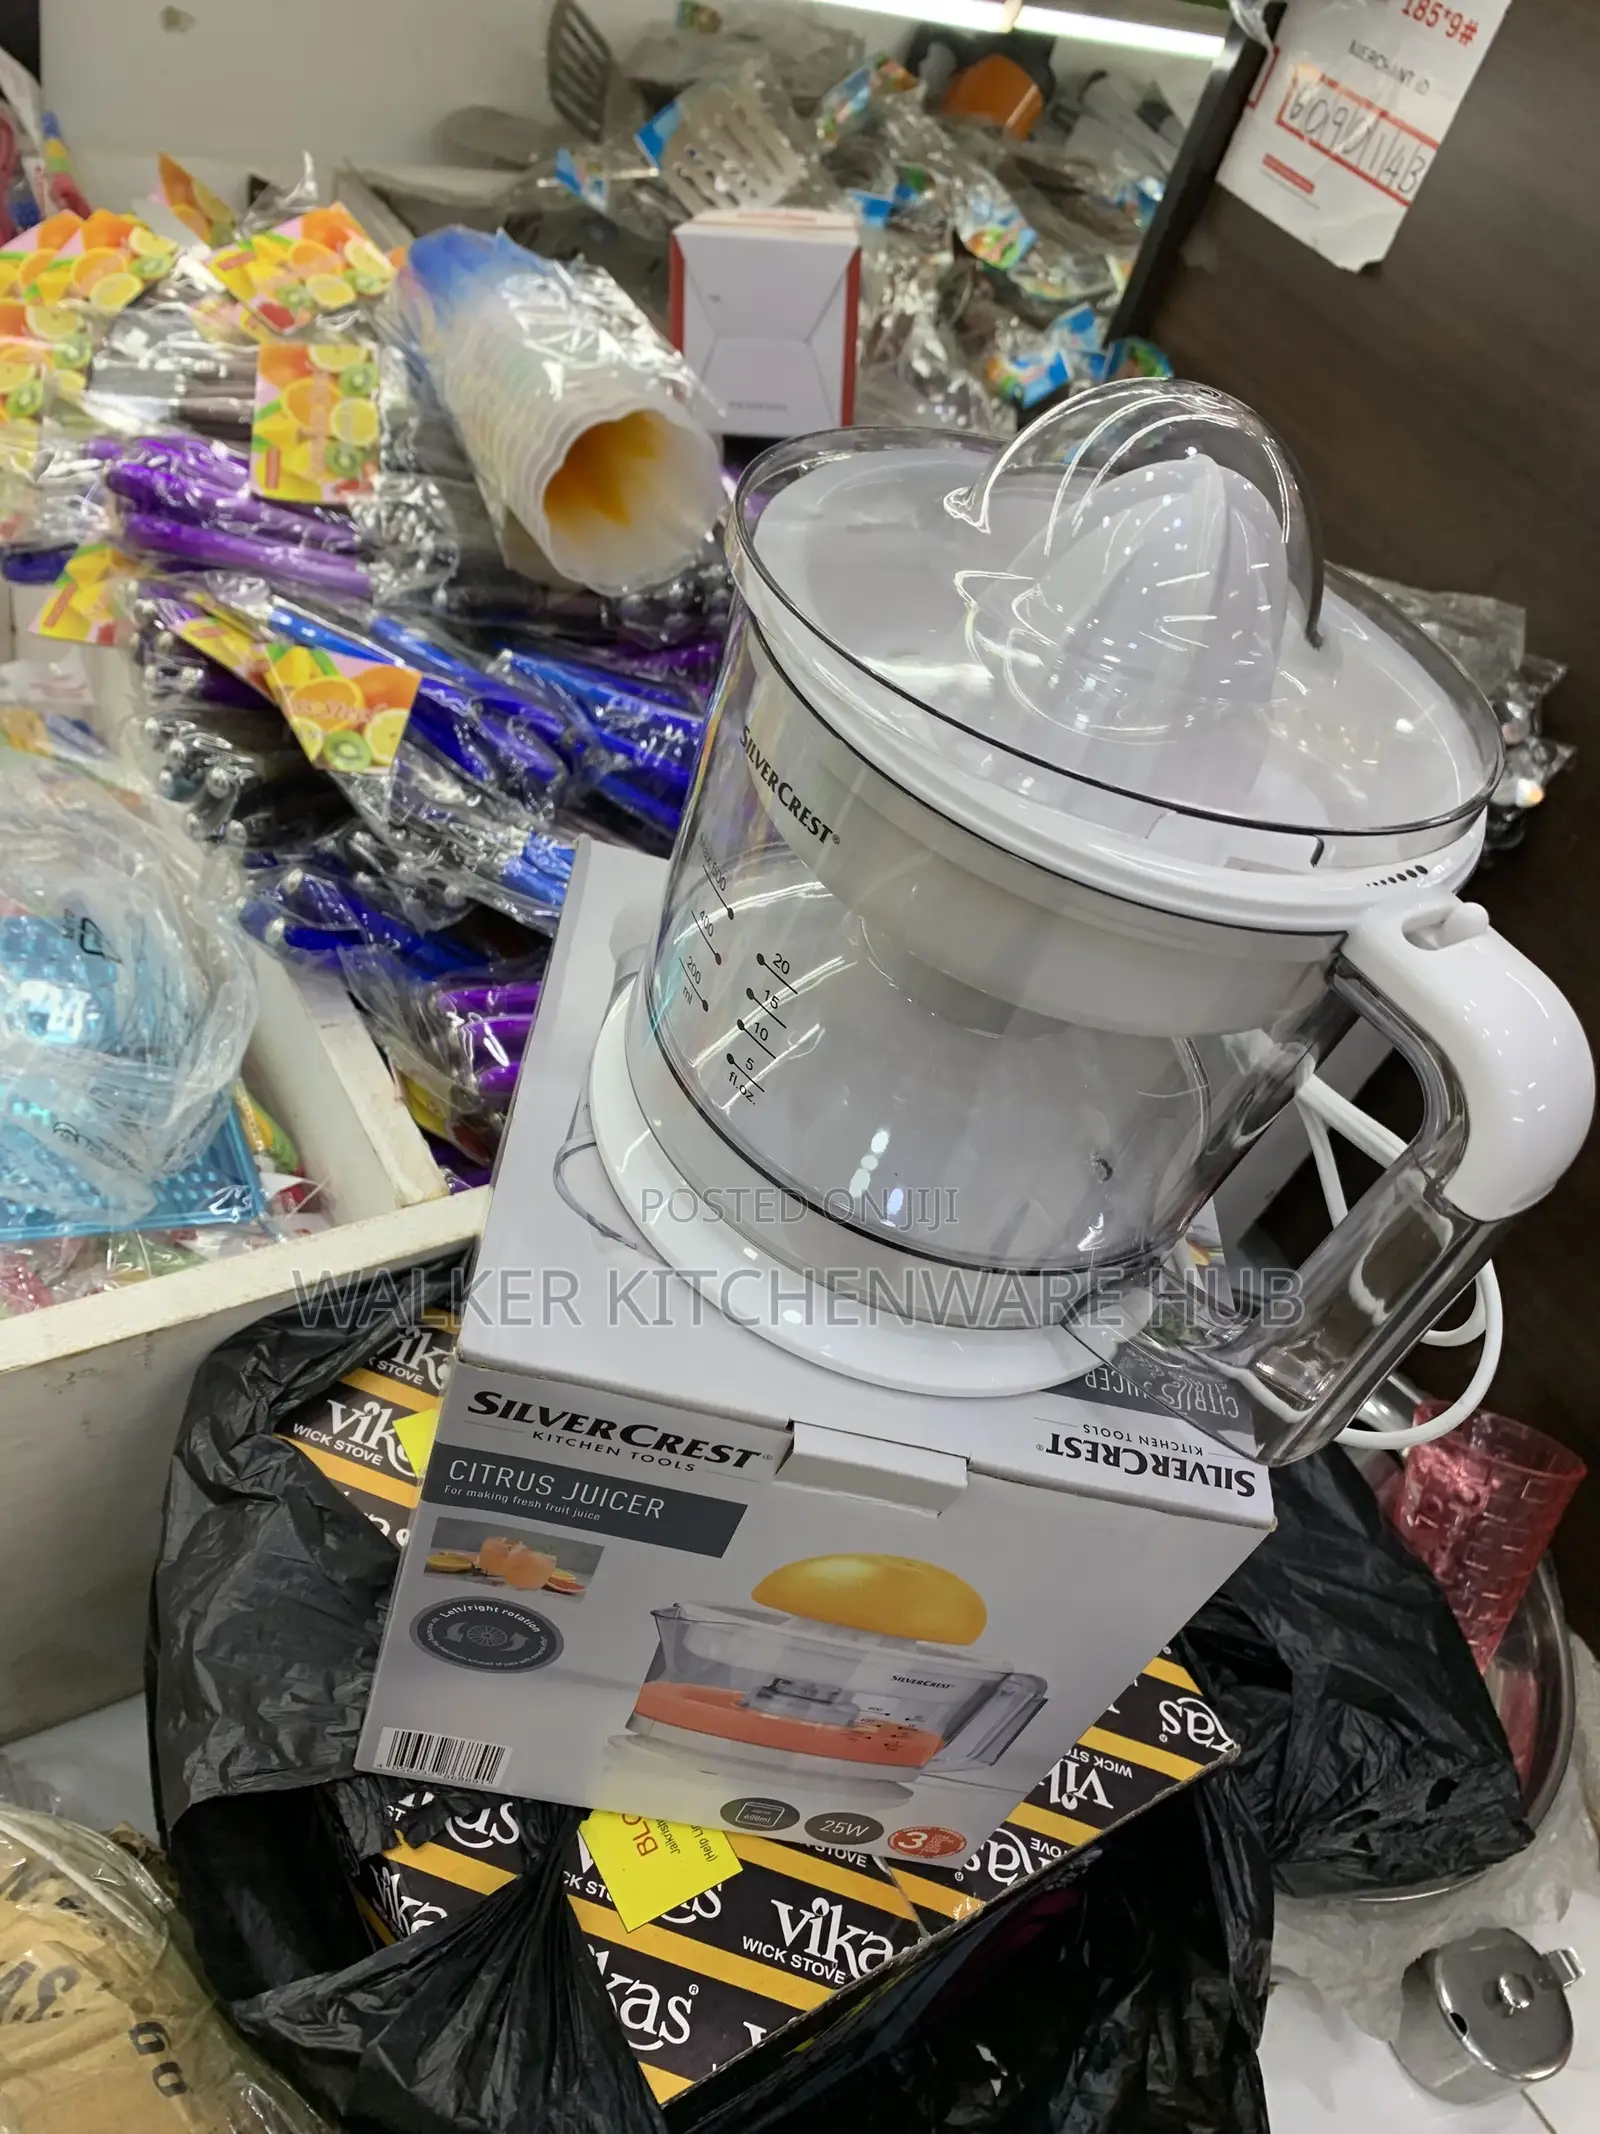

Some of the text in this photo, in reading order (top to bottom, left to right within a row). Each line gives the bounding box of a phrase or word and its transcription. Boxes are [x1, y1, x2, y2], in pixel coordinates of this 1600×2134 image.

[686, 955, 702, 985] 200
[772, 952, 791, 976] 20
[763, 989, 780, 1010] 15
[753, 1021, 770, 1042] 10
[745, 1057, 756, 1072] 5
[376, 1360, 425, 1386] STOVE
[293, 1422, 384, 1467] WICK STOVE
[532, 1430, 697, 1473] KITCHEN TOOLS
[1082, 1423, 1204, 1457] KITCHEN TOOLS
[449, 1459, 666, 1520] CITRUS JUICER
[444, 1484, 602, 1522] For making fresh fruit juice
[501, 1609, 542, 1634] rotation
[1093, 1755, 1134, 1779] WICK
[819, 1819, 871, 1838] 25W
[897, 1830, 929, 1850] 3
[770, 1897, 894, 1980] vika
[742, 1935, 846, 1985] WICK STOVE
